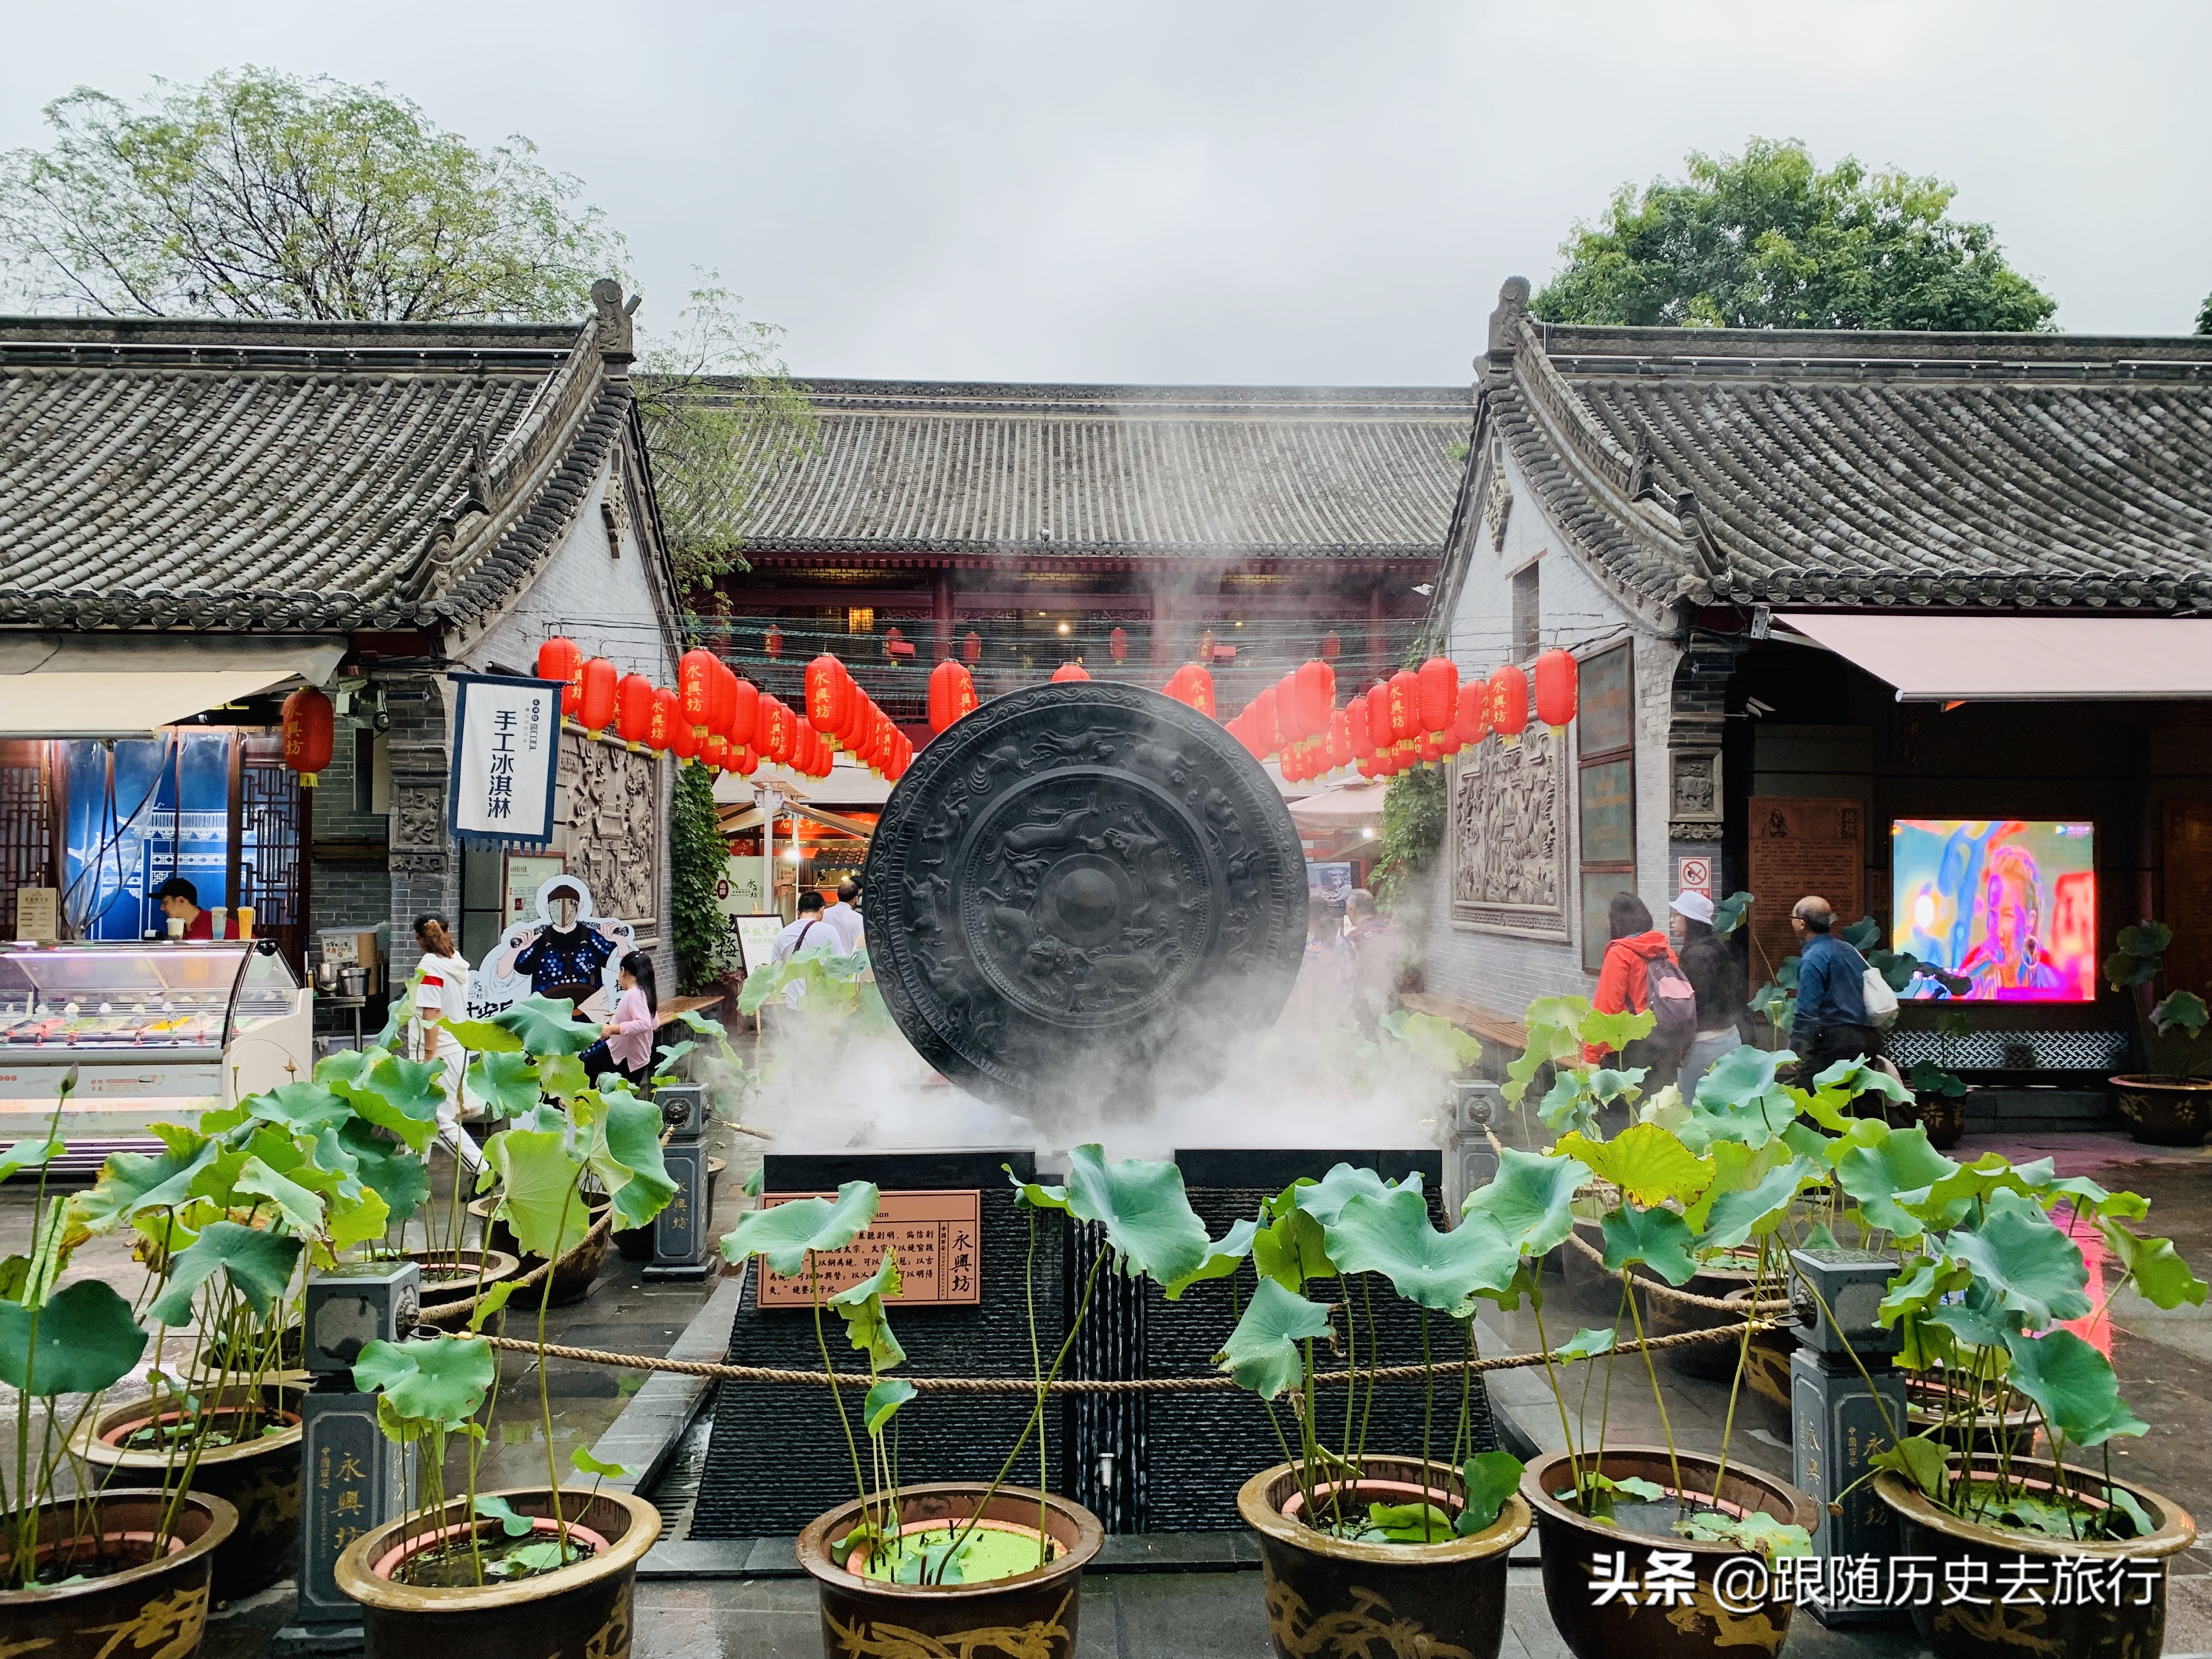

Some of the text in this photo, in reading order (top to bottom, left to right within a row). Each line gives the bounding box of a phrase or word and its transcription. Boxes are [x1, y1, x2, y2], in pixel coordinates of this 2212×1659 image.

[685, 663, 704, 712] 永興坊
[813, 670, 832, 719] 永興坊
[1190, 678, 1207, 709] 永興
[1390, 684, 1404, 729] 永興坊
[1492, 678, 1508, 723] 永興坊
[285, 702, 304, 755] 永興坊
[651, 699, 665, 740] 永興坊
[769, 708, 782, 747] 永興坊
[487, 710, 517, 819] 手工冰淇淋
[949, 1231, 973, 1292] 永興坊
[330, 1452, 366, 1549] 永興坊
